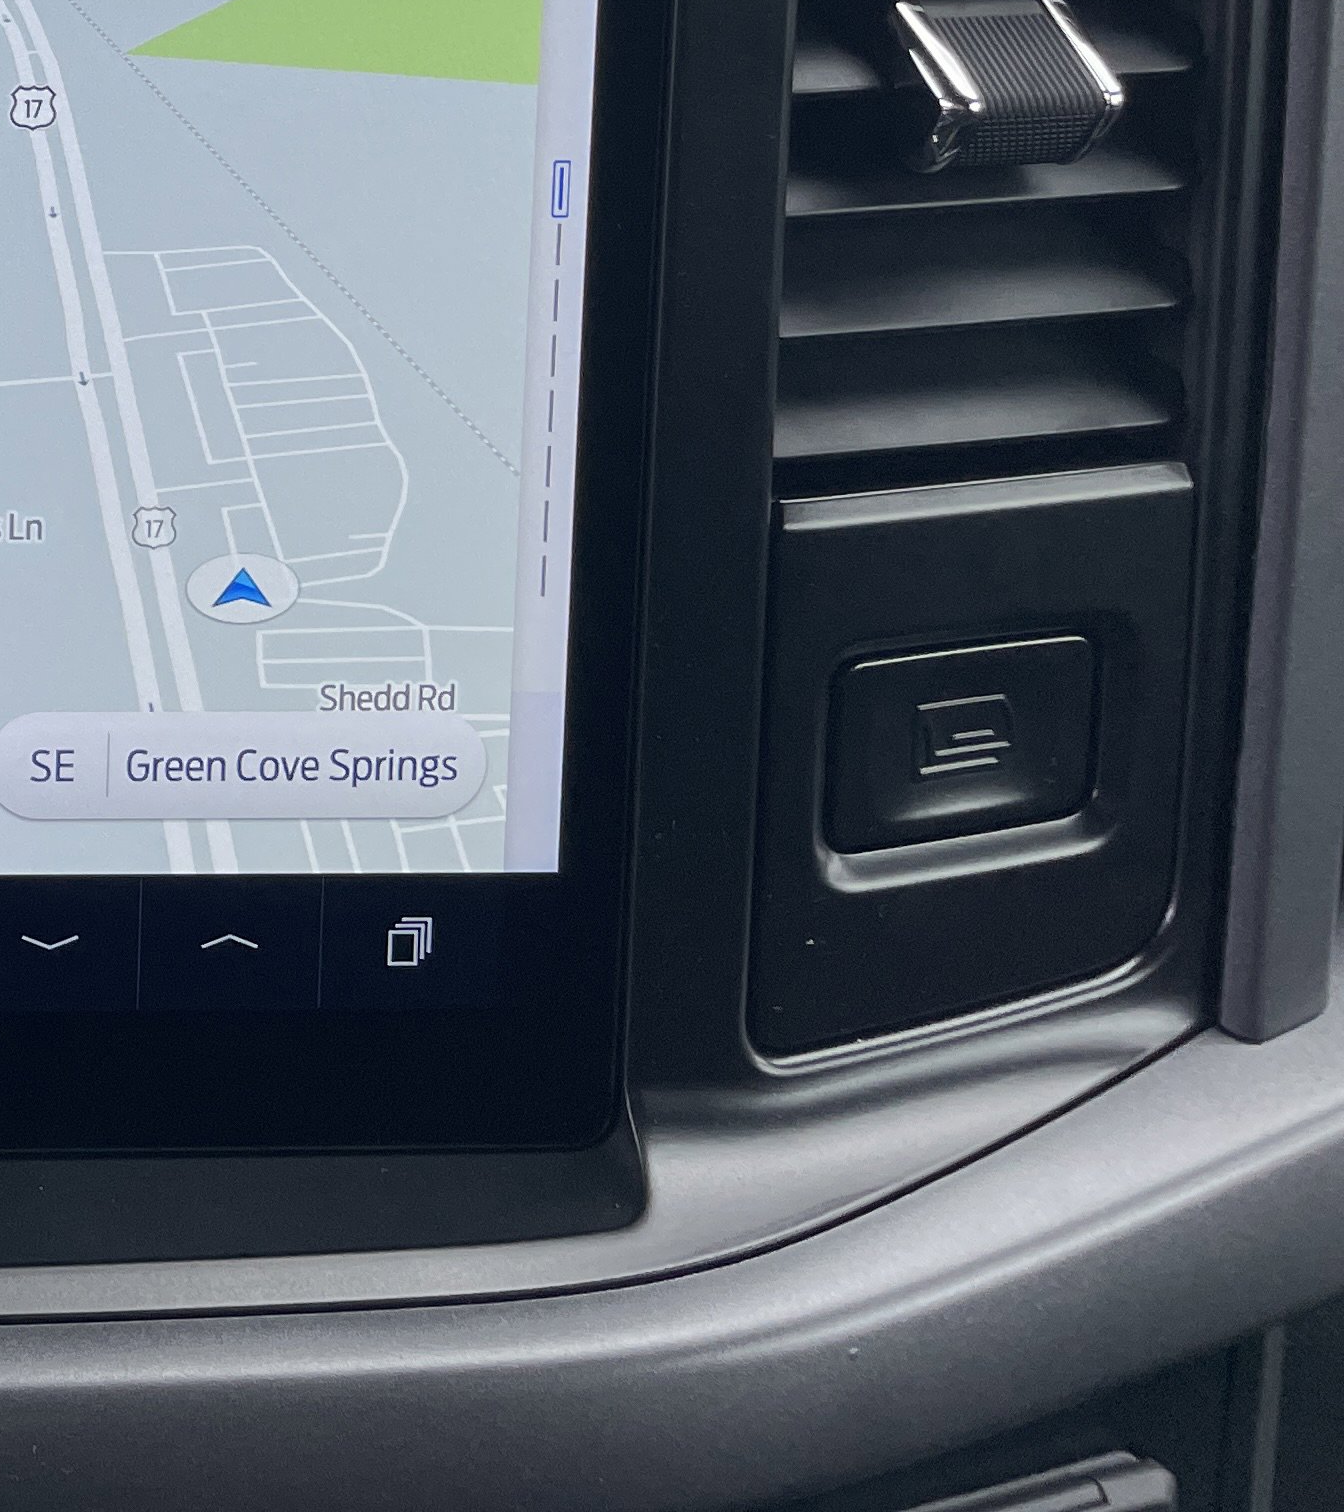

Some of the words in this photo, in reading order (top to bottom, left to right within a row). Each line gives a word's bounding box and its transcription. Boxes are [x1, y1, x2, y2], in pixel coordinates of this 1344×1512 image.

[24, 99, 44, 119] 17
[9, 512, 43, 541] Ln
[145, 519, 165, 539] 17
[318, 682, 411, 713] Shedd
[418, 682, 456, 713] Rd
[30, 749, 75, 783] SE
[126, 749, 226, 782] Green
[236, 748, 320, 782] Cove
[329, 748, 458, 788] Springs
